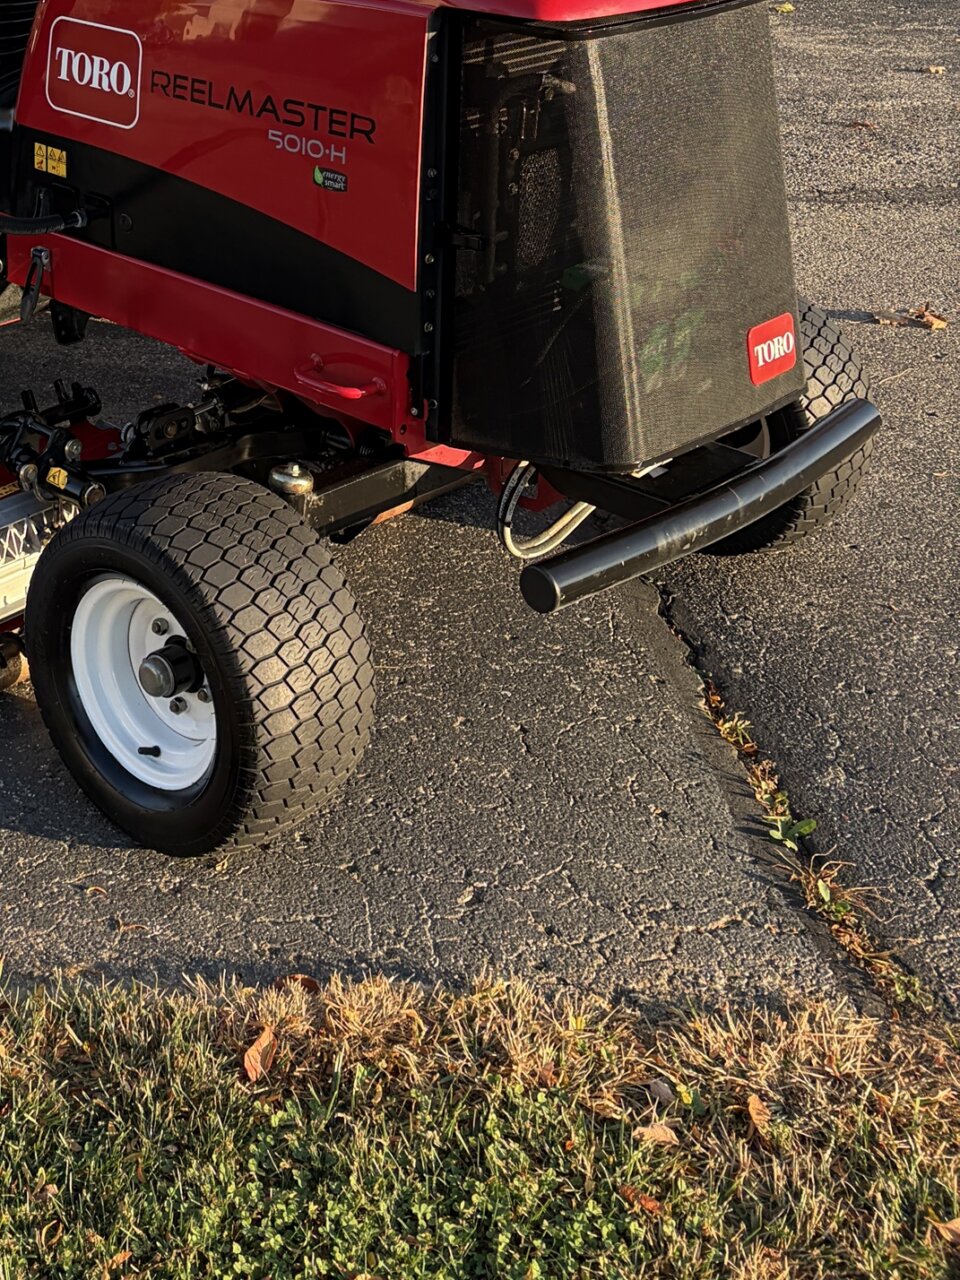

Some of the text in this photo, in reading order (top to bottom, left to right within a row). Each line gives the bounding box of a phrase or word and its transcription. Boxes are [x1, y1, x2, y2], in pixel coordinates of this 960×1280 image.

[151, 70, 377, 144] REELMASTER
[322, 171, 346, 182] energy
[324, 179, 346, 191] smart
[754, 332, 794, 367] TORO
